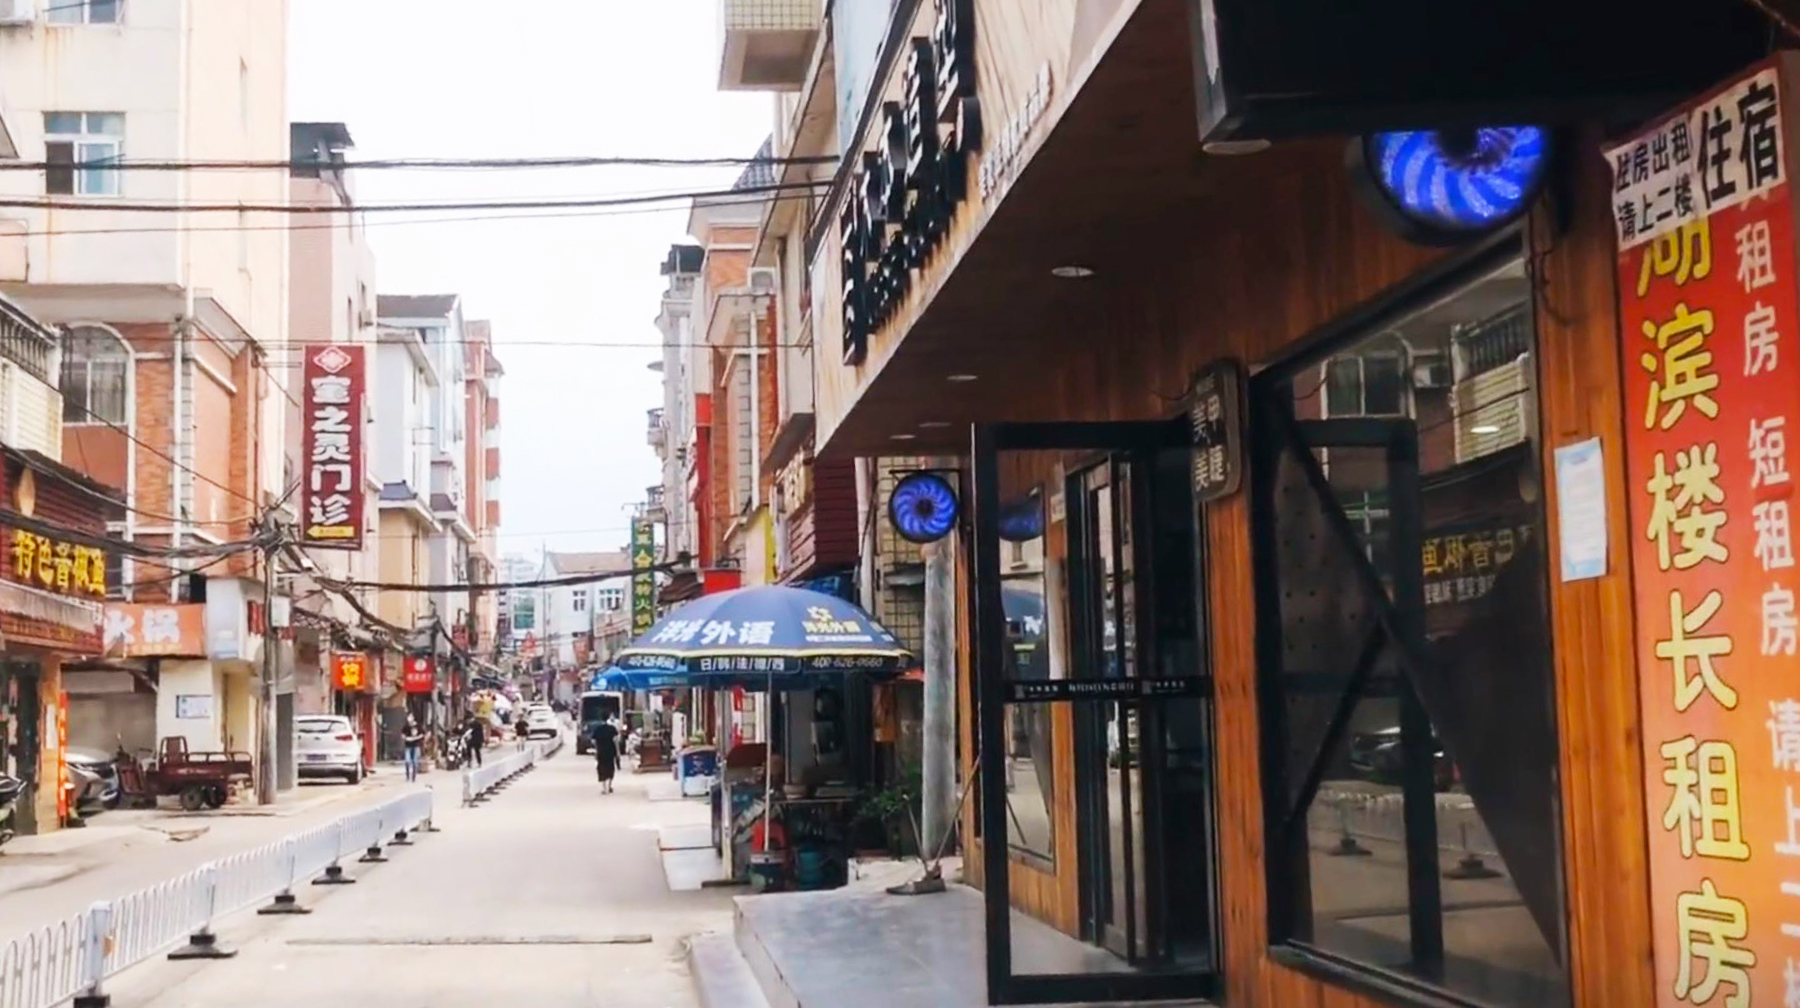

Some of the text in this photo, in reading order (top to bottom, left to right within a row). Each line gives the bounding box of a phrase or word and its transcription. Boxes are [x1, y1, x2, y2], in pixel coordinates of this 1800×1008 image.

[1615, 120, 1690, 193] 住房出租
[1617, 173, 1693, 241] 请上二楼
[1697, 81, 1778, 209] 住宿
[1735, 195, 1779, 377] 租房
[1748, 415, 1799, 656] 短租房
